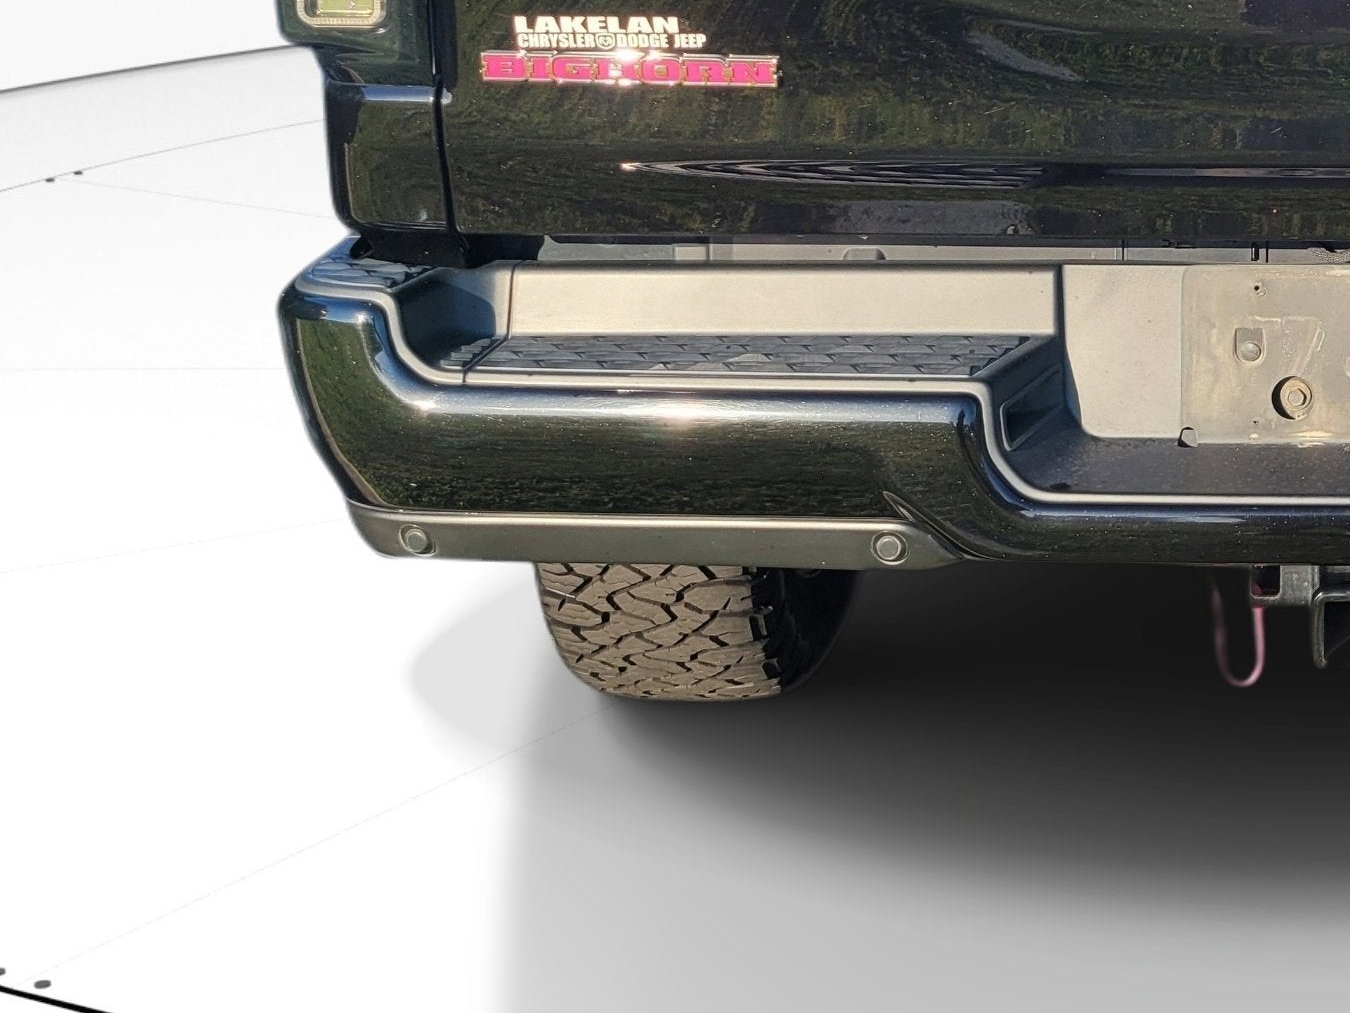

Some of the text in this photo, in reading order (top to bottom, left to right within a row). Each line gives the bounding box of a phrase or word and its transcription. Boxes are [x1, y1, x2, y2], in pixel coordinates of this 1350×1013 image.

[514, 16, 679, 34] LAKELAN
[517, 34, 707, 48] CHRYSLER DODGE JEEP
